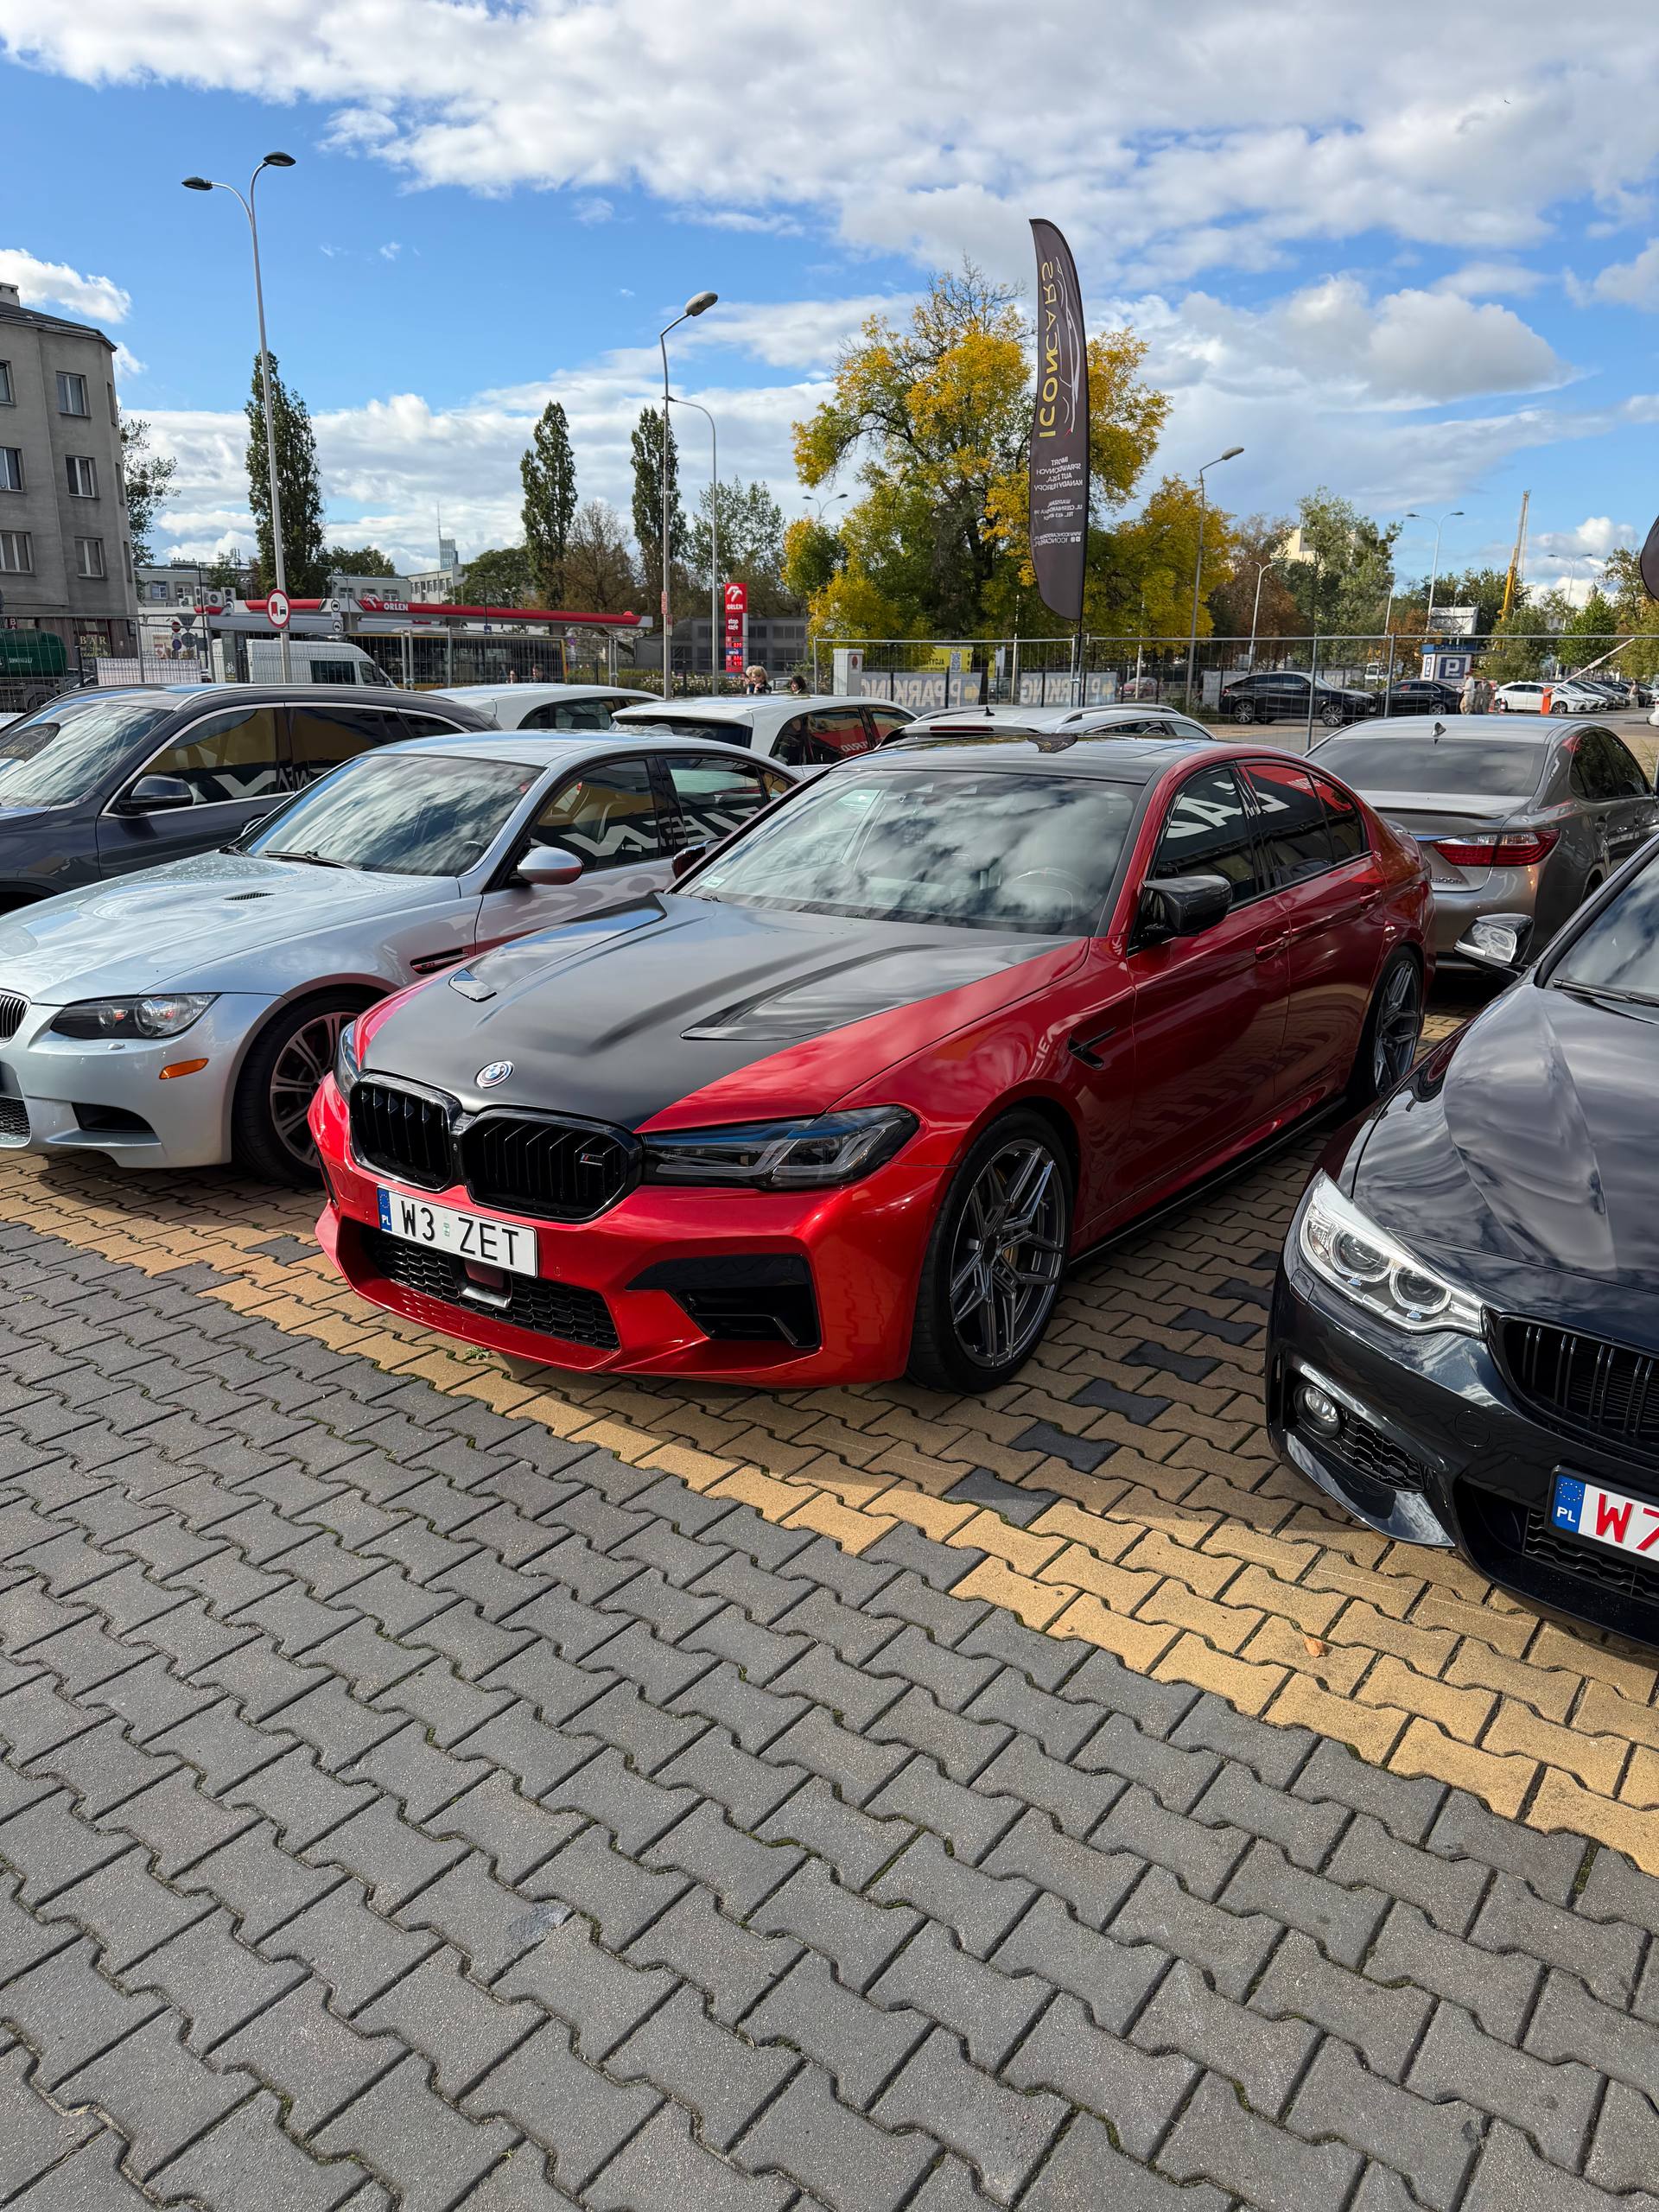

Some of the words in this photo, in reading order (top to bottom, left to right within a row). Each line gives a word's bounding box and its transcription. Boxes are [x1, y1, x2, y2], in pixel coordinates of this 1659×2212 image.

[383, 602, 409, 611] ORLEN
[80, 635, 107, 645] BAR
[382, 1214, 391, 1226] PL
[401, 1200, 435, 1242] W3
[458, 1217, 519, 1266] ZET
[1557, 1506, 1576, 1523] PL
